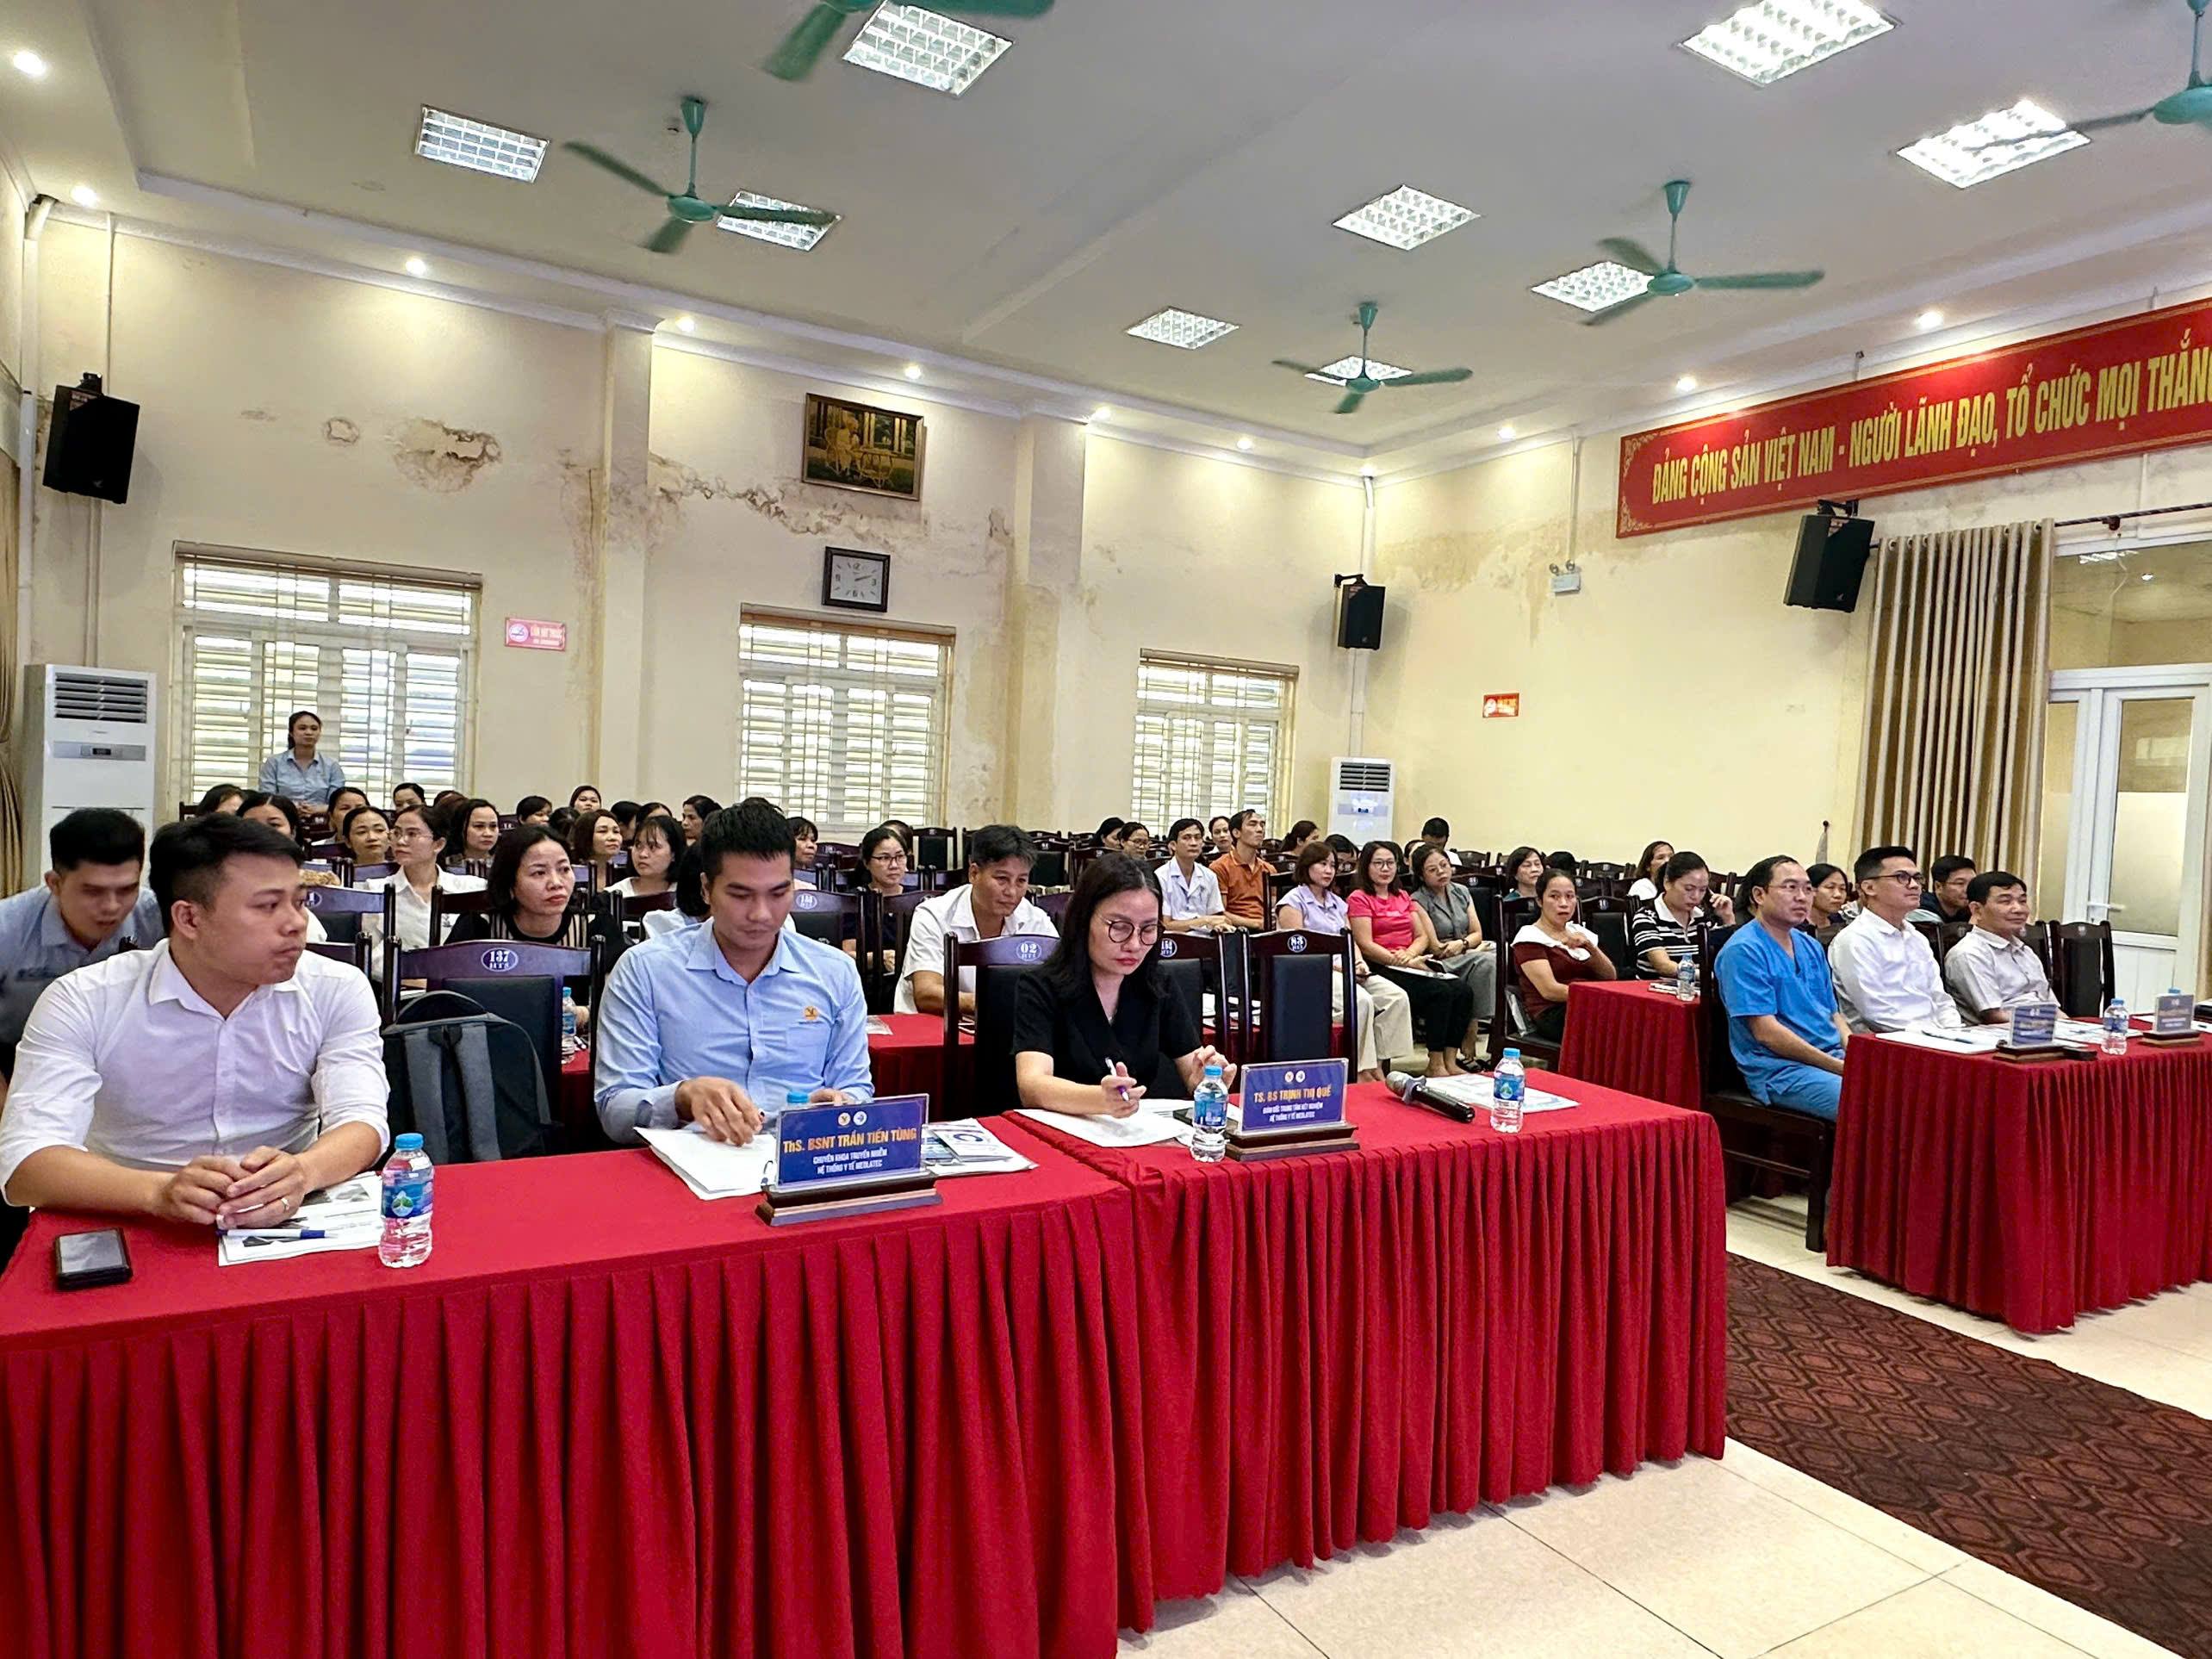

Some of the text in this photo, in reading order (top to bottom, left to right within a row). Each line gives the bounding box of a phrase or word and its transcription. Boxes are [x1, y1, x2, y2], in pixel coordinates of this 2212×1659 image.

[1652, 447, 1687, 505] ĐẢNG
[1690, 444, 1727, 505] CỘNG
[1730, 429, 1761, 490] SẢN
[1764, 426, 1795, 491] VIỆT
[1798, 426, 1836, 476] NAM
[1838, 444, 1845, 455] -
[1849, 401, 1902, 468] NGƯỜI
[1904, 396, 1954, 457] LÃNH
[1955, 392, 1998, 457] ĐẠO,
[2006, 363, 2034, 439] TỔ
[2035, 363, 2091, 434] CHỨC
[2095, 361, 2141, 431] MỌI
[1020, 943, 1037, 954] 02
[489, 950, 510, 962] 137
[1254, 1091, 1265, 1103] TS.
[1267, 1090, 1278, 1102] BS
[783, 1139, 805, 1153] ThS.
[808, 1135, 836, 1151] BSNT
